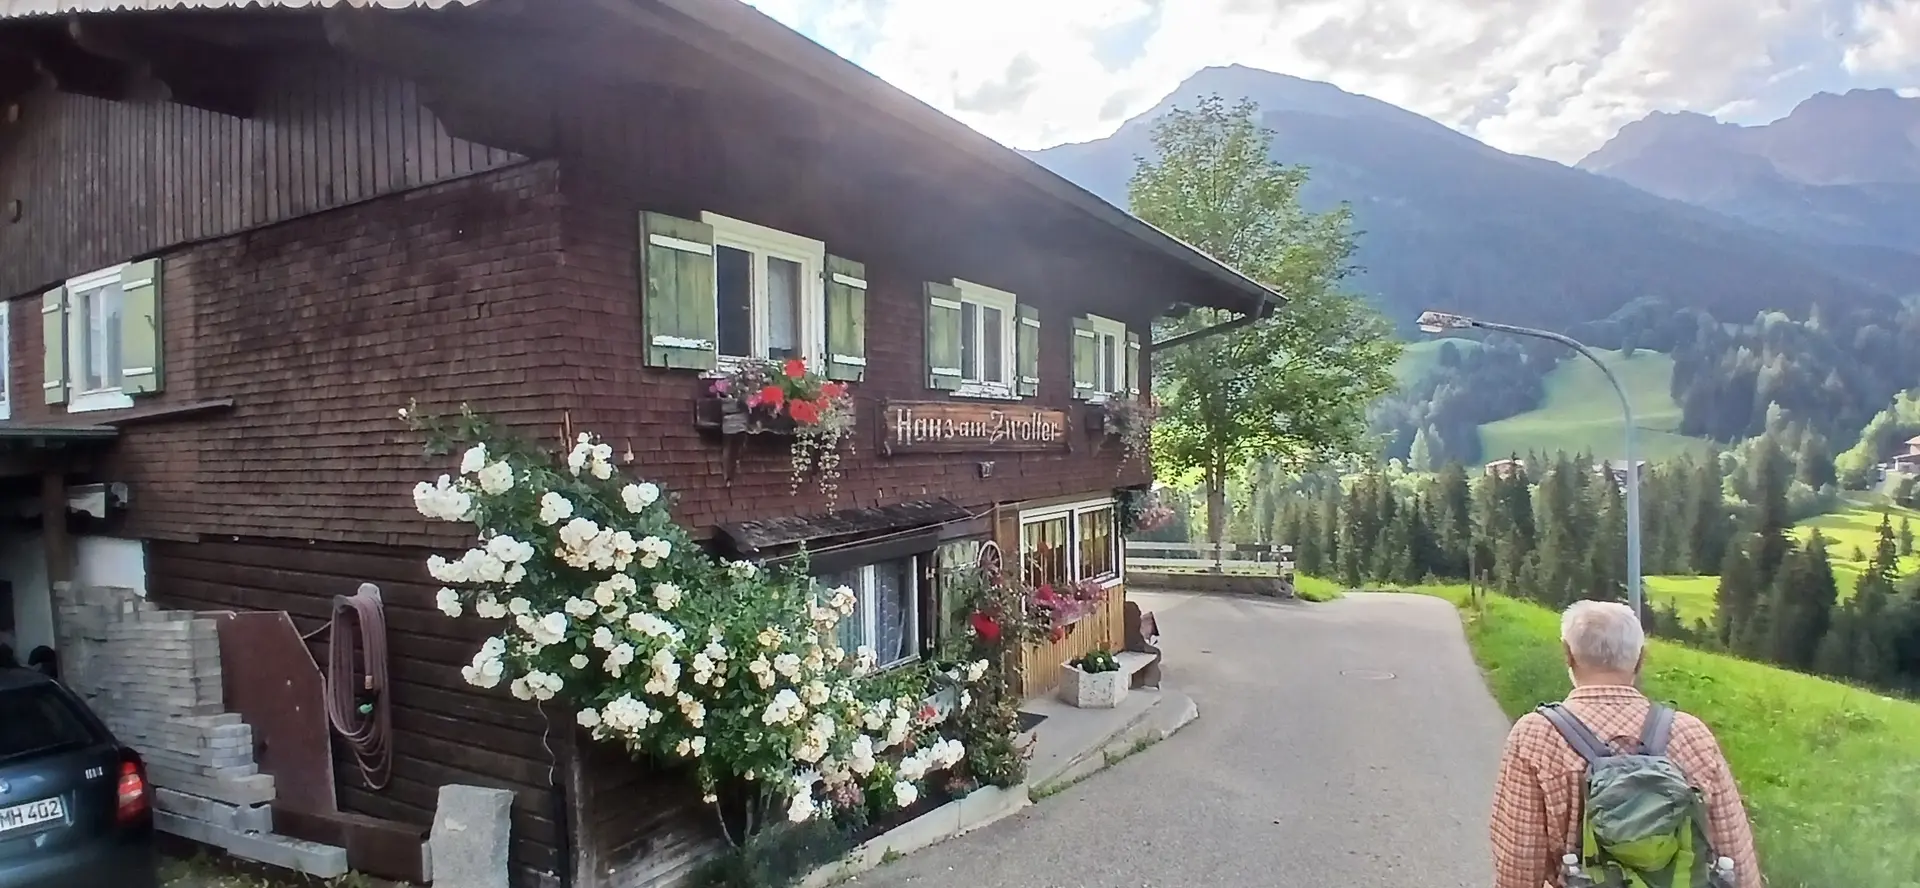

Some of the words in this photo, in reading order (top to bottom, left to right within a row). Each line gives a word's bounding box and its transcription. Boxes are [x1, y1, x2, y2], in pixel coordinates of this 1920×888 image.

[897, 408, 955, 446] Haus
[959, 421, 986, 437] am
[28, 800, 60, 821] 402
